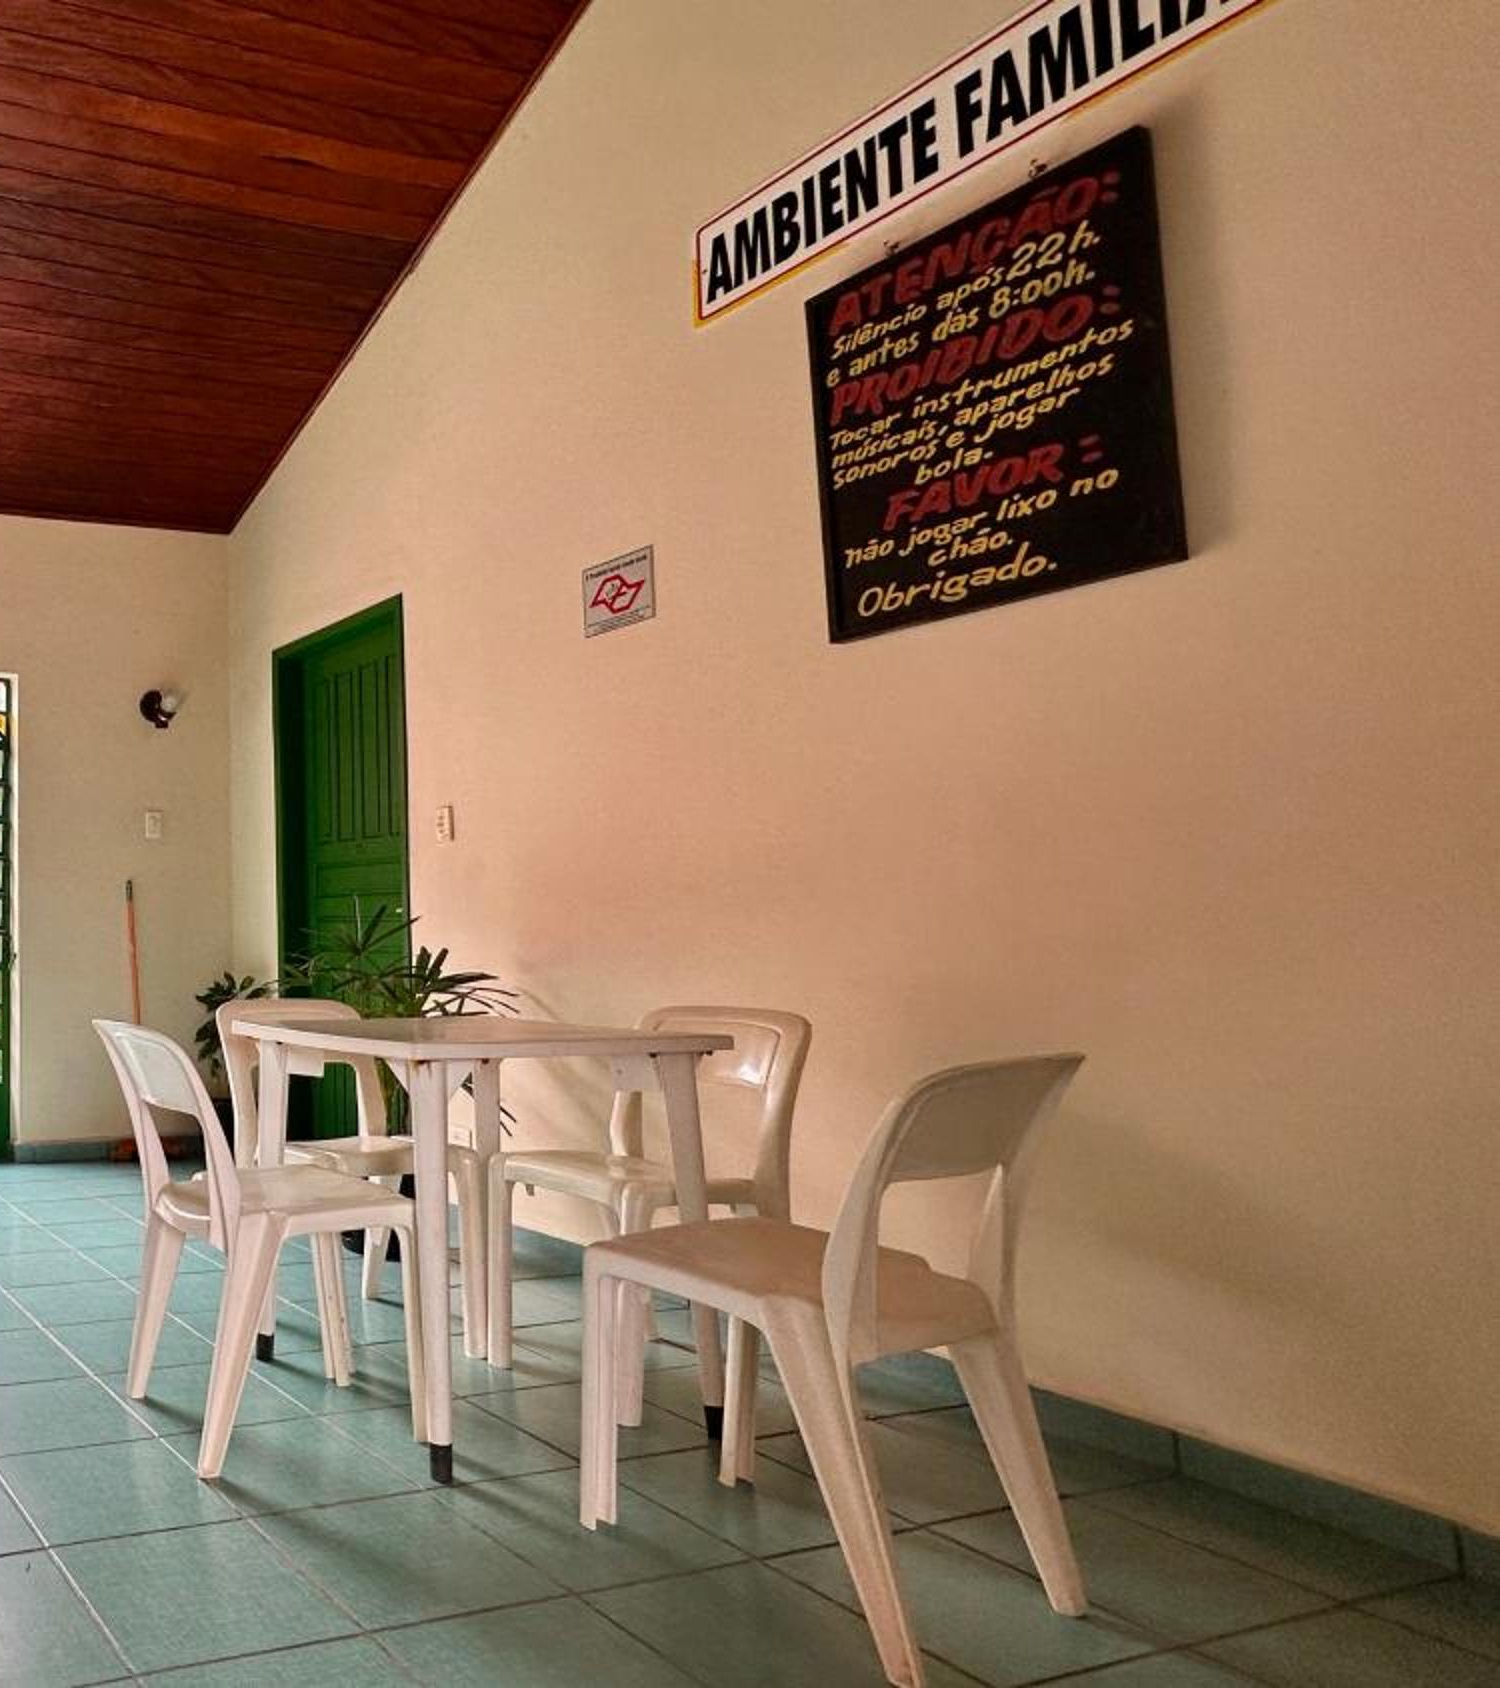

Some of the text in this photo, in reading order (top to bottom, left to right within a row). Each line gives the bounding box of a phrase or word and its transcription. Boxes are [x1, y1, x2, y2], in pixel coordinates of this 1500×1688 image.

[705, 0, 1229, 305] AMBIENTE FAMIL
[829, 170, 1121, 337] ATENÇÃO:
[825, 371, 840, 388] e
[849, 331, 920, 378] antes
[988, 261, 1096, 320] 8:00h.
[829, 285, 1121, 427] PROIBIDO:
[831, 303, 926, 361] Silêncio
[935, 264, 1001, 313] após
[828, 318, 1134, 450] Tocar instrumentos
[953, 352, 1115, 428] aparelhos
[833, 387, 1081, 490] sonoros e jogar
[914, 446, 994, 486] bola.
[844, 467, 1120, 569] não jogar lixo no
[927, 526, 1015, 568] chão.
[856, 541, 1058, 618] Obrigado.
